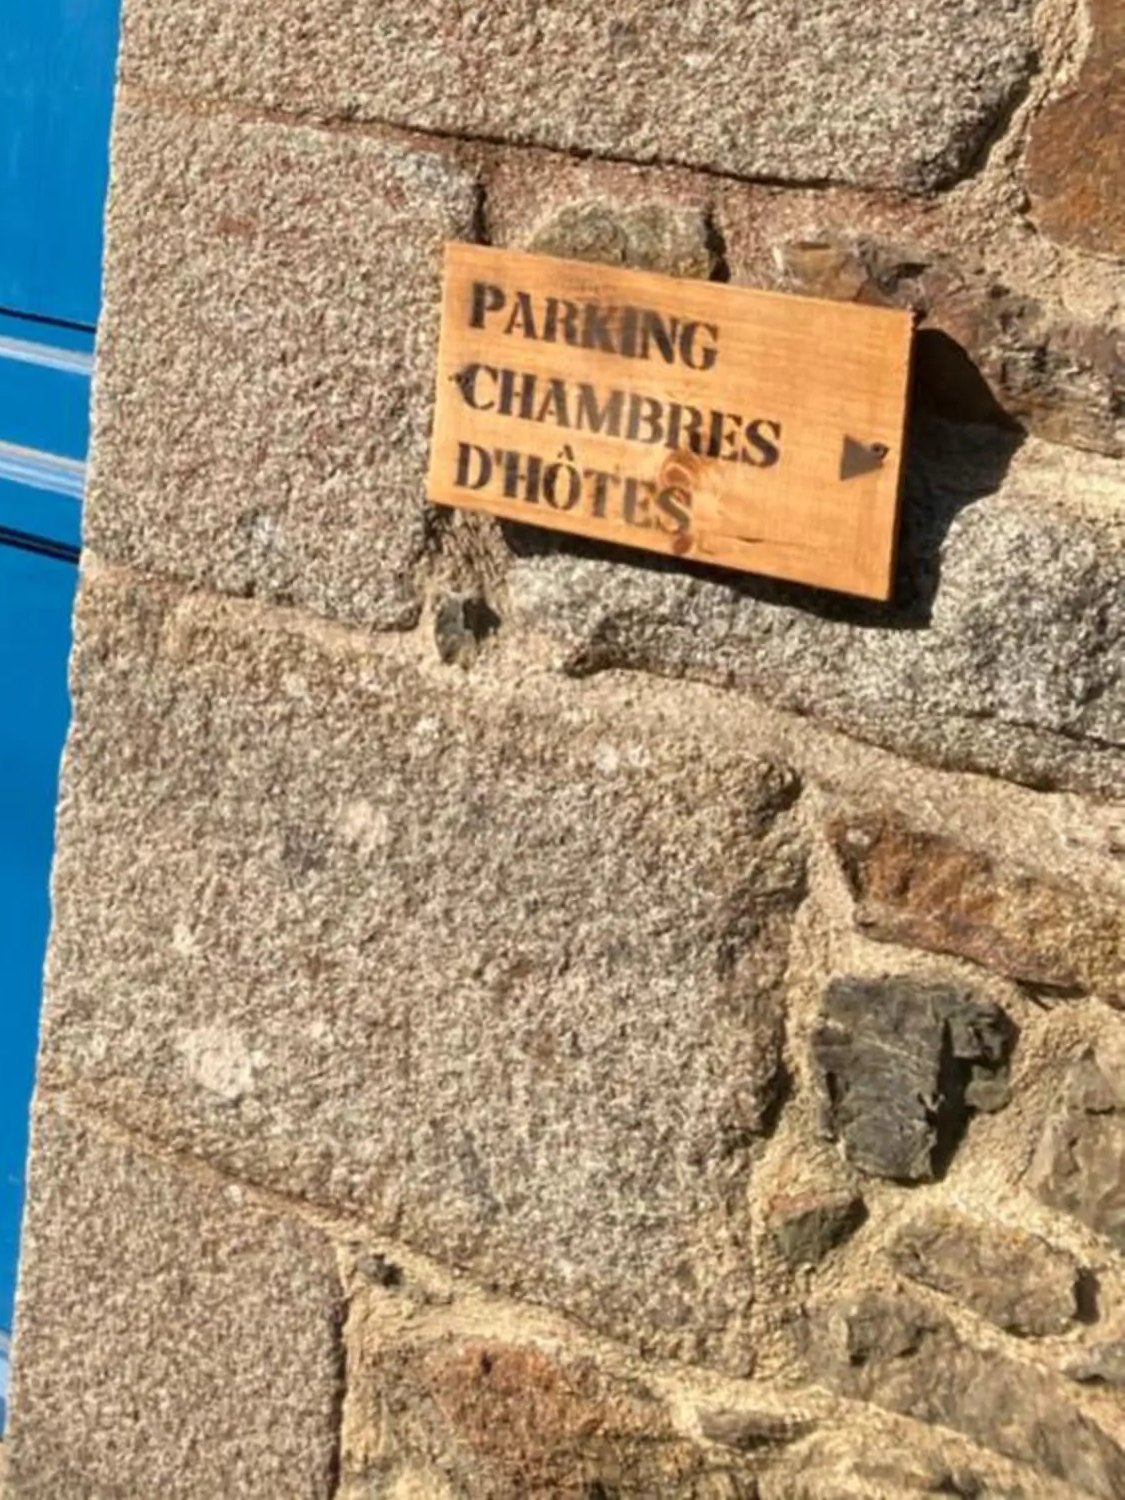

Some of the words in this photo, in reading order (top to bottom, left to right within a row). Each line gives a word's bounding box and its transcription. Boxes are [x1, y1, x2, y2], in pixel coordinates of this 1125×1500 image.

[467, 280, 719, 371] PARKING
[460, 362, 782, 468] CHAMBRES
[453, 441, 695, 533] D'HÔTES
